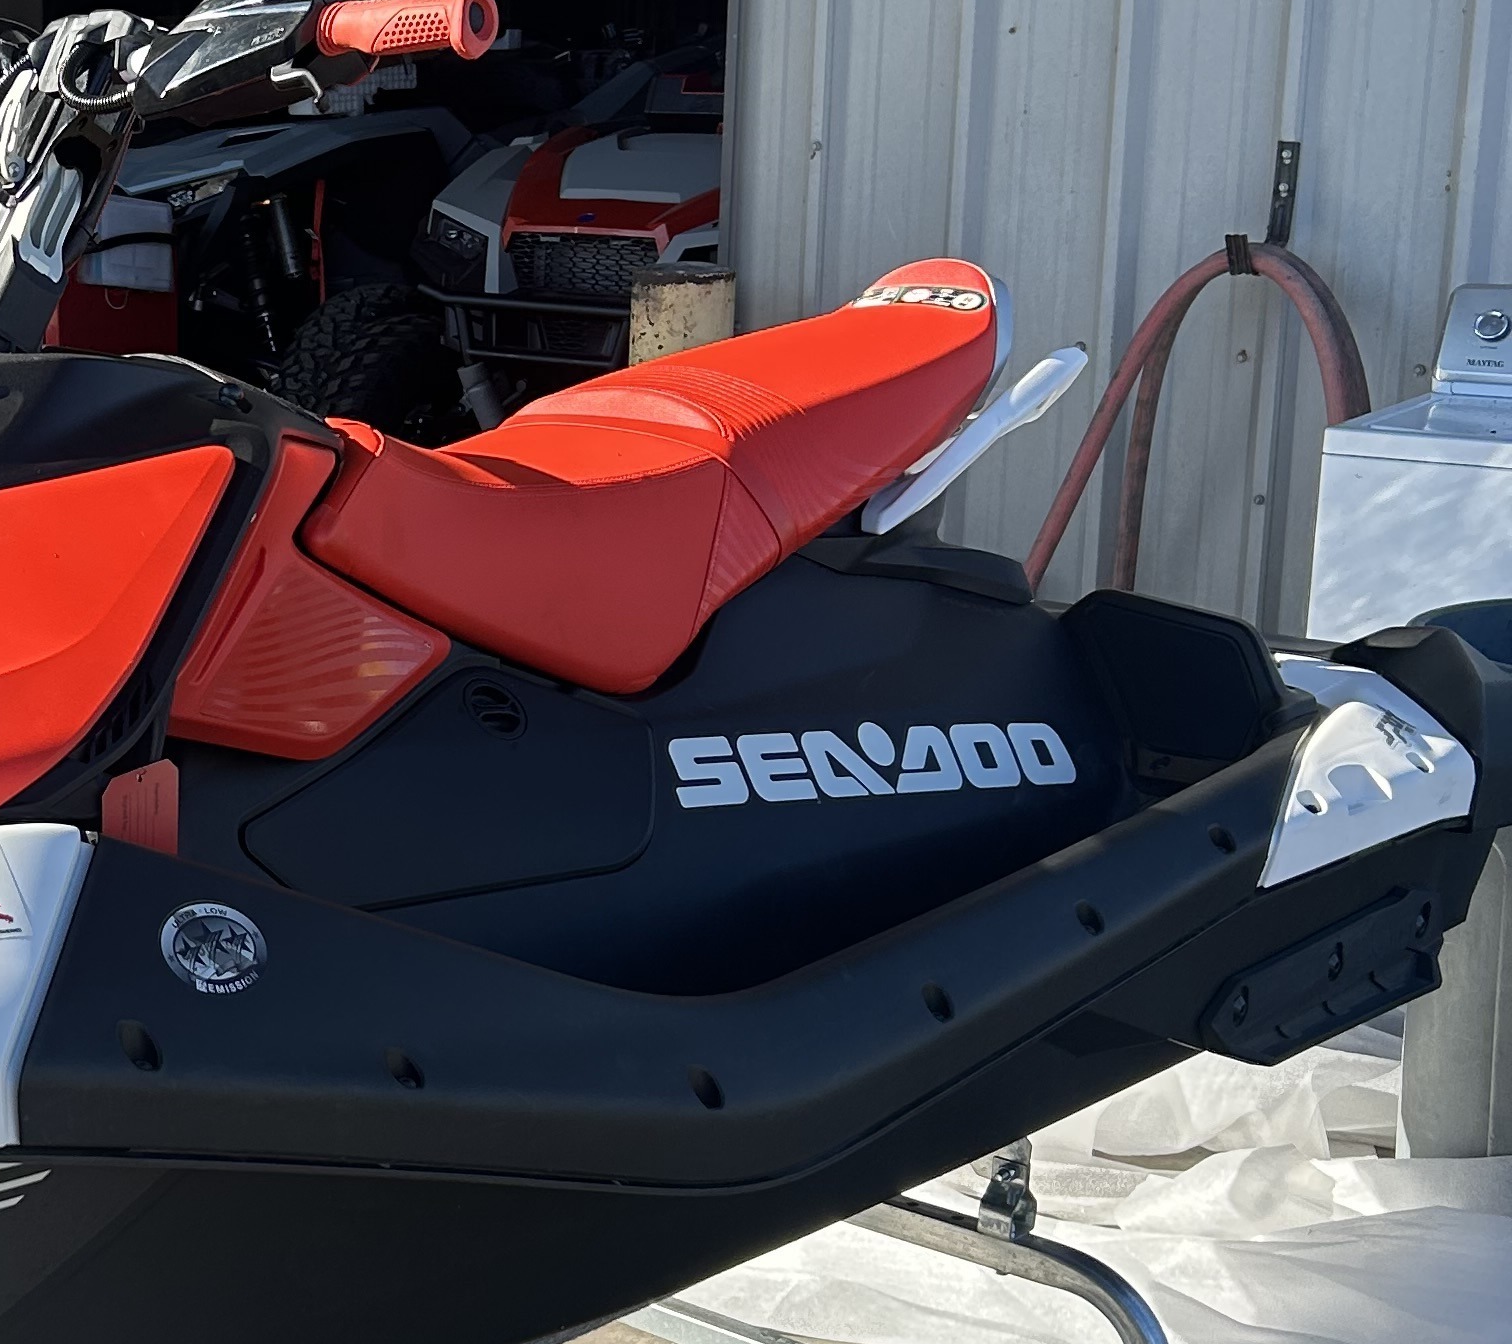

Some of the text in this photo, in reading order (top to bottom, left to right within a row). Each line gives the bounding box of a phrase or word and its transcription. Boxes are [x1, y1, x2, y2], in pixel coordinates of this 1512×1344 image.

[1466, 358, 1504, 367] MAYTAG
[171, 907, 228, 929] ULTRA LOW
[208, 969, 259, 994] EMISSION
